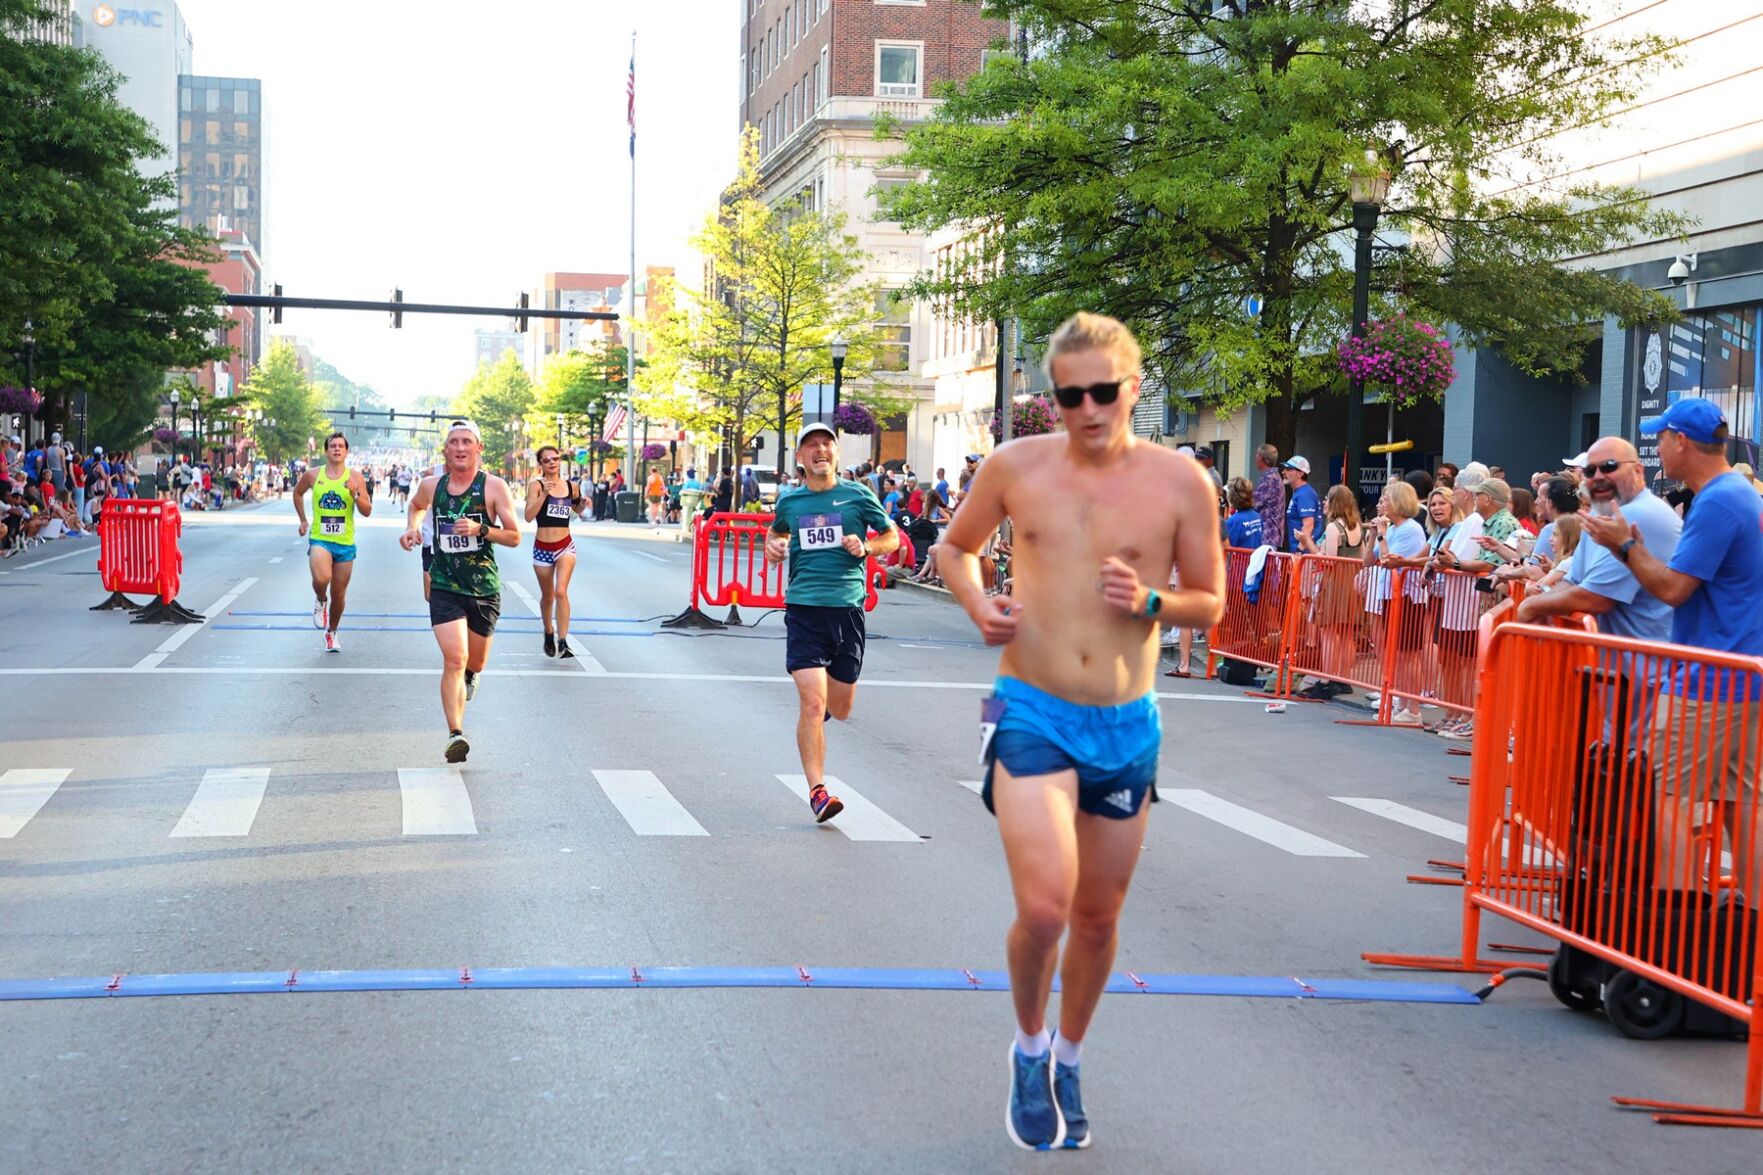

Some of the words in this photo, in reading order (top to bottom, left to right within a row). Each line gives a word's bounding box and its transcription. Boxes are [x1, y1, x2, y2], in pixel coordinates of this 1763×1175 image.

[117, 8, 162, 27] PNC
[1641, 400, 1659, 409] DIGNITY
[1640, 446, 1648, 456] SET
[549, 505, 570, 516] 2363
[902, 515, 911, 527] 3
[325, 524, 340, 532] 512
[807, 527, 835, 544] 549
[446, 535, 469, 549] 189
